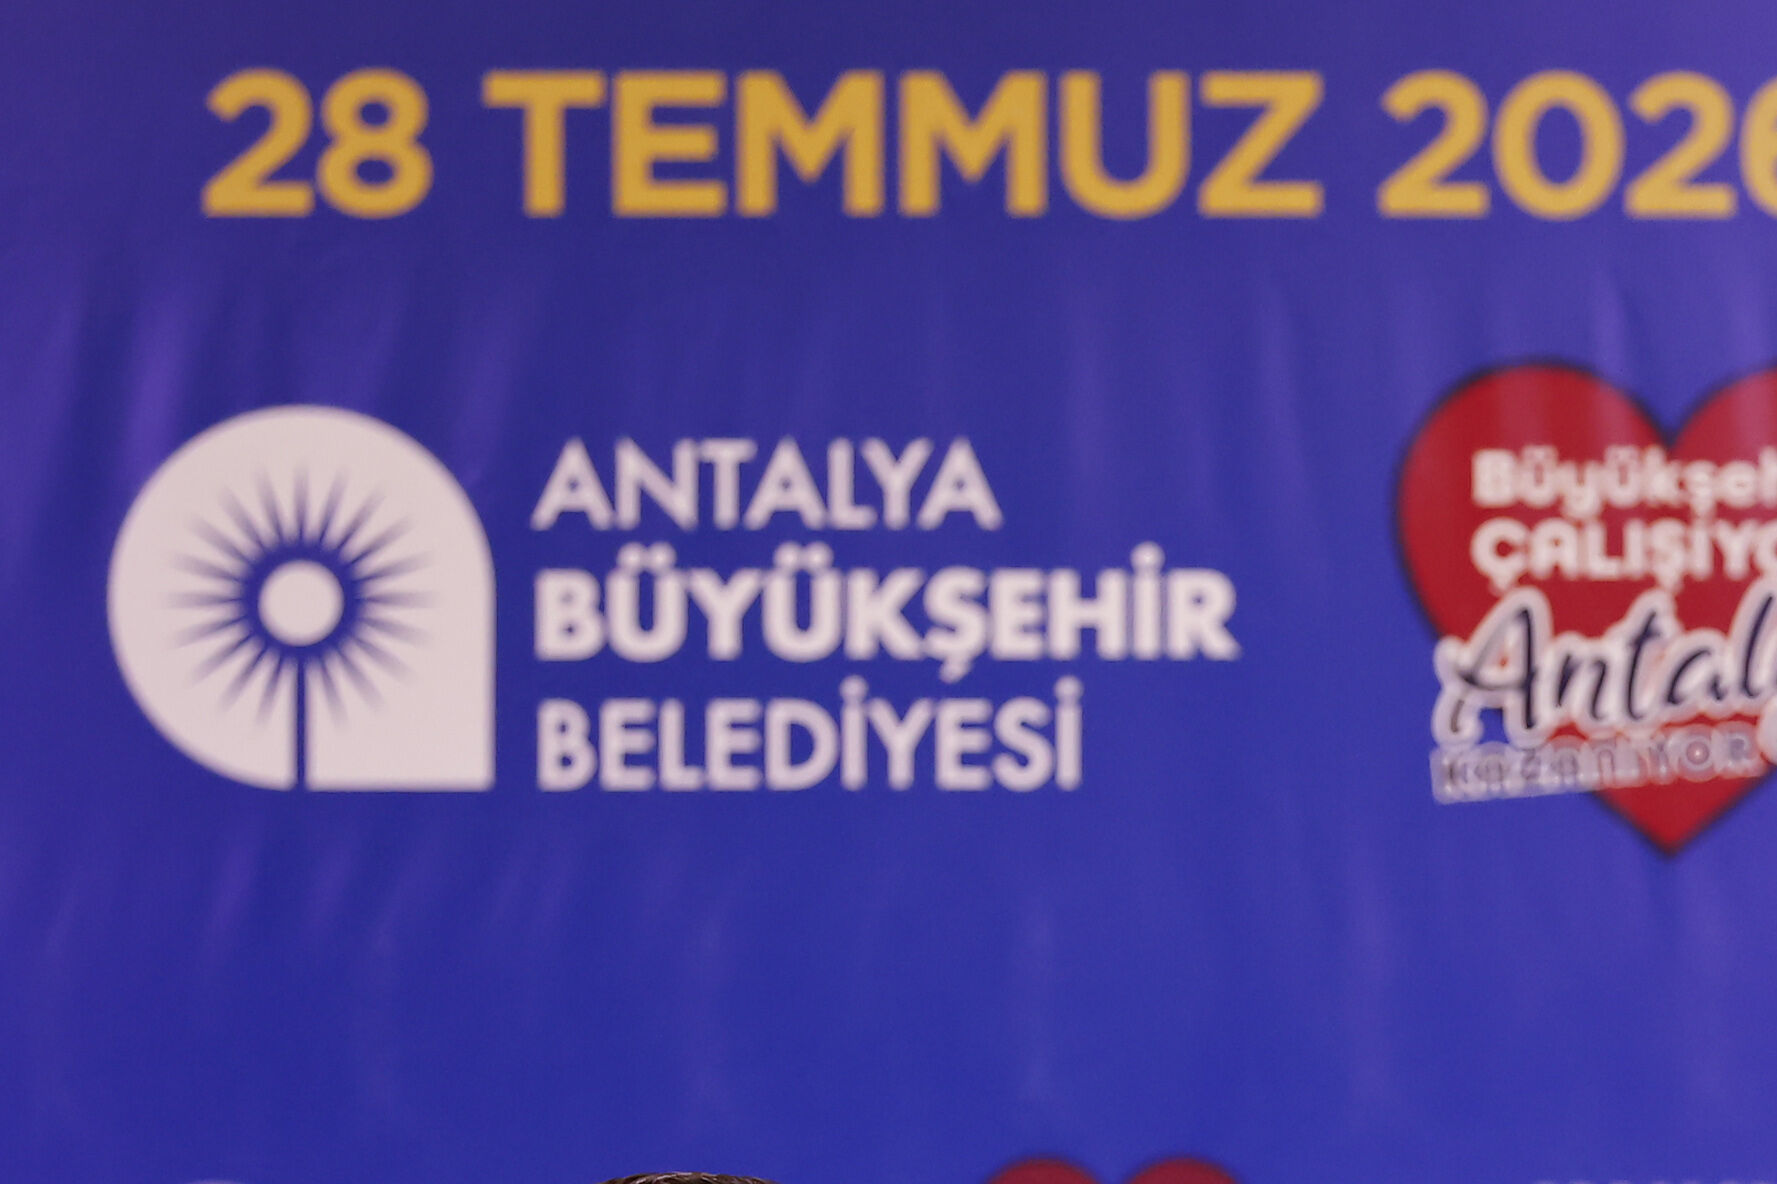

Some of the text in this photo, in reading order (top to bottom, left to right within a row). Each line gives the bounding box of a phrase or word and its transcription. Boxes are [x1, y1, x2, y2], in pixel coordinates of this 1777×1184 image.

[202, 68, 433, 219] 28
[482, 70, 1325, 219] TEMMUZ
[532, 438, 1002, 530] ANTALYA
[534, 543, 1239, 682] BÜYÜKŞEHİR
[536, 676, 1083, 792] BELEDİYESİ
